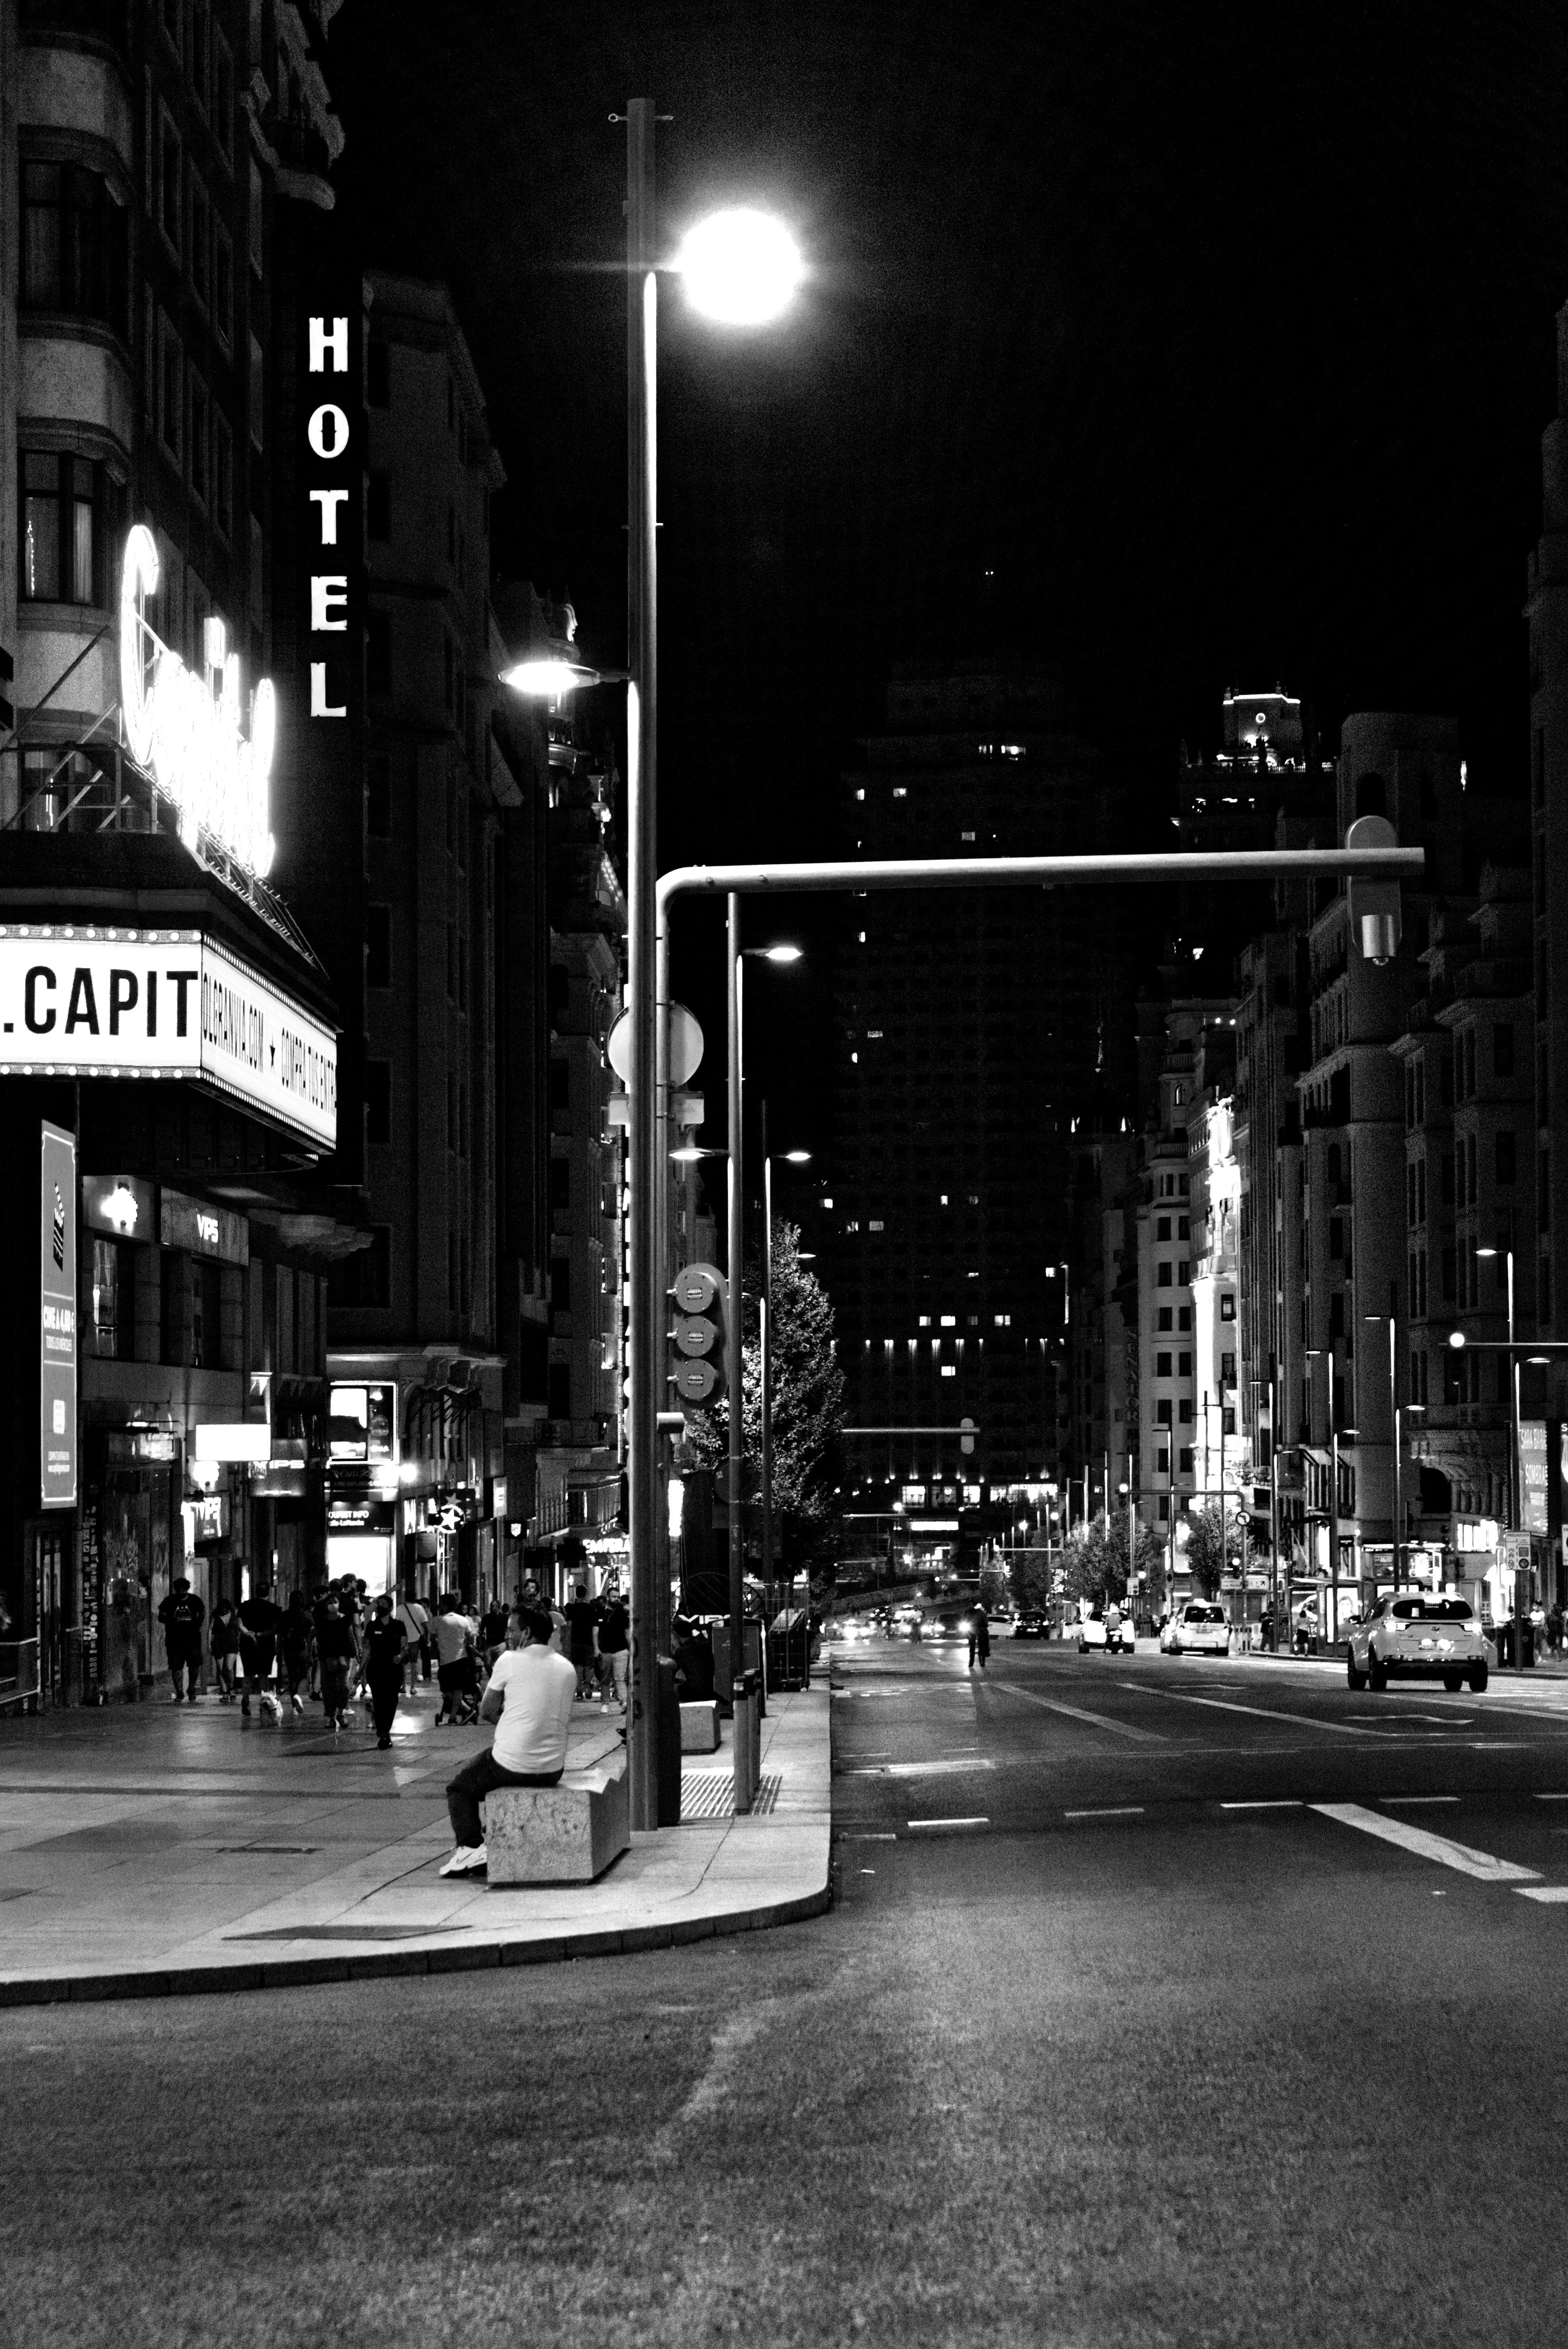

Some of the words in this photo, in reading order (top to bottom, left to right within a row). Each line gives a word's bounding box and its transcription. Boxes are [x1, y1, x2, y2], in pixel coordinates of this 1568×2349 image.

[308, 317, 349, 718] HOTEL
[197, 1213, 219, 1243] VIPS
[43, 1305, 55, 1329] CINE
[253, 1460, 305, 1469] VIPS
[678, 1614, 731, 1625] VIP
